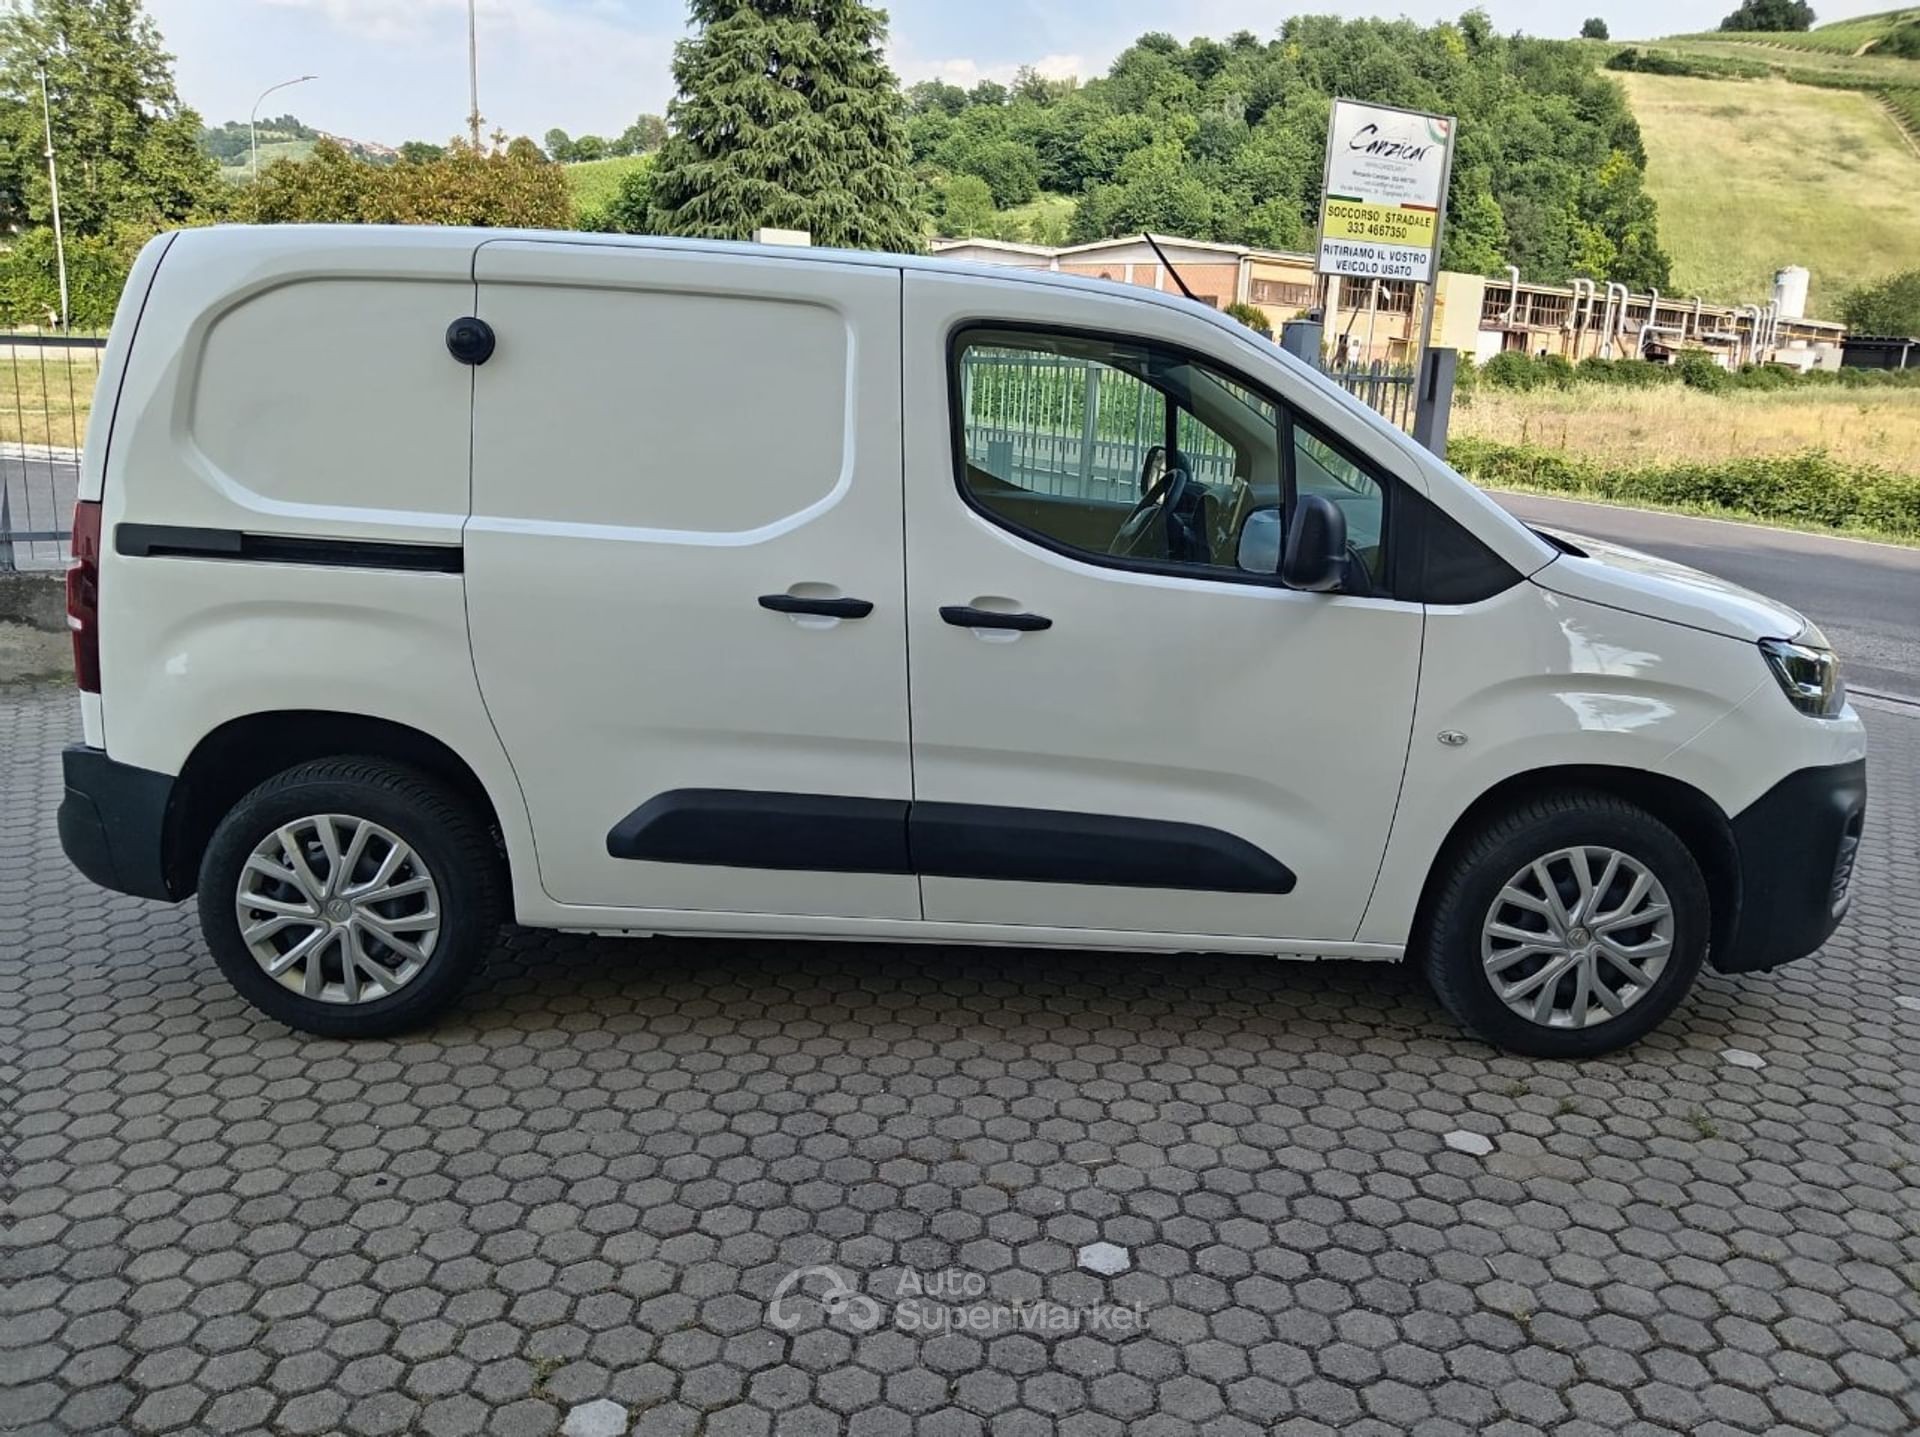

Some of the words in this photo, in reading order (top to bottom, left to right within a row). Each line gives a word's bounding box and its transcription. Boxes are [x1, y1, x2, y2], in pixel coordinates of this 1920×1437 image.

[1350, 123, 1434, 161] Canzicar
[1328, 206, 1380, 222] SOCCORSO
[1385, 212, 1431, 228] STRADALE
[1347, 221, 1365, 234] 333
[1367, 224, 1408, 239] 4667350
[1323, 244, 1375, 258] RITIRIAMO
[1377, 250, 1386, 261] IL
[1390, 251, 1427, 264] VOSTRO
[1336, 260, 1379, 274] VEICOLO
[1381, 263, 1412, 277] USATO
